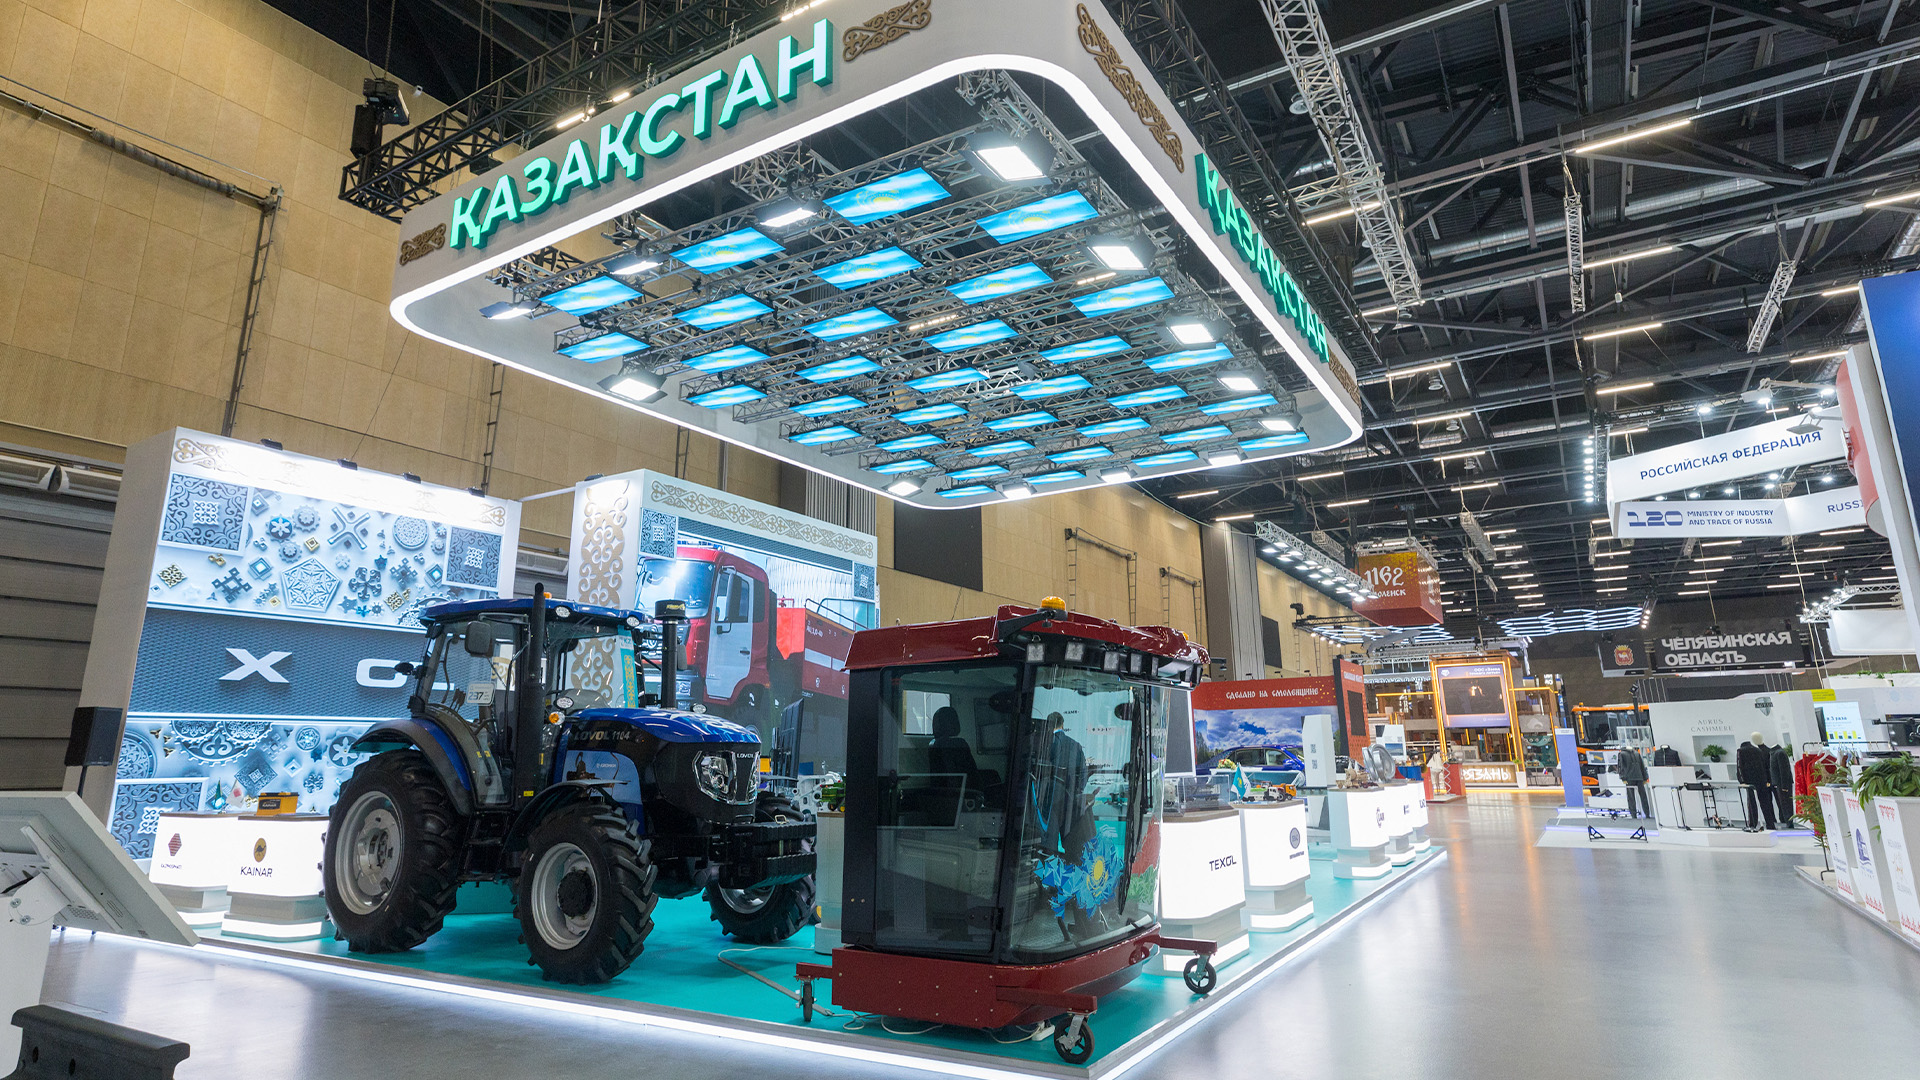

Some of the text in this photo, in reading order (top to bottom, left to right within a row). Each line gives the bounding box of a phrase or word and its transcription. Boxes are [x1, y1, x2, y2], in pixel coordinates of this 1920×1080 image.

[450, 18, 833, 249] ҚАЗАҚСТАН
[1195, 153, 1330, 363] ҚАЗАҚСТАН
[1640, 431, 1822, 480] РОССИЙСКАЯ ФЕДЕРАЦИЯ
[1661, 631, 1793, 651] ЧЕЛЯБИНСКАЯ
[1665, 650, 1747, 667] ОБЛАСТЬ
[1259, 690, 1269, 698] НА
[574, 731, 609, 741] LOVOL
[1690, 725, 1734, 733] CASHMERE
[240, 866, 273, 877] KAINAR
